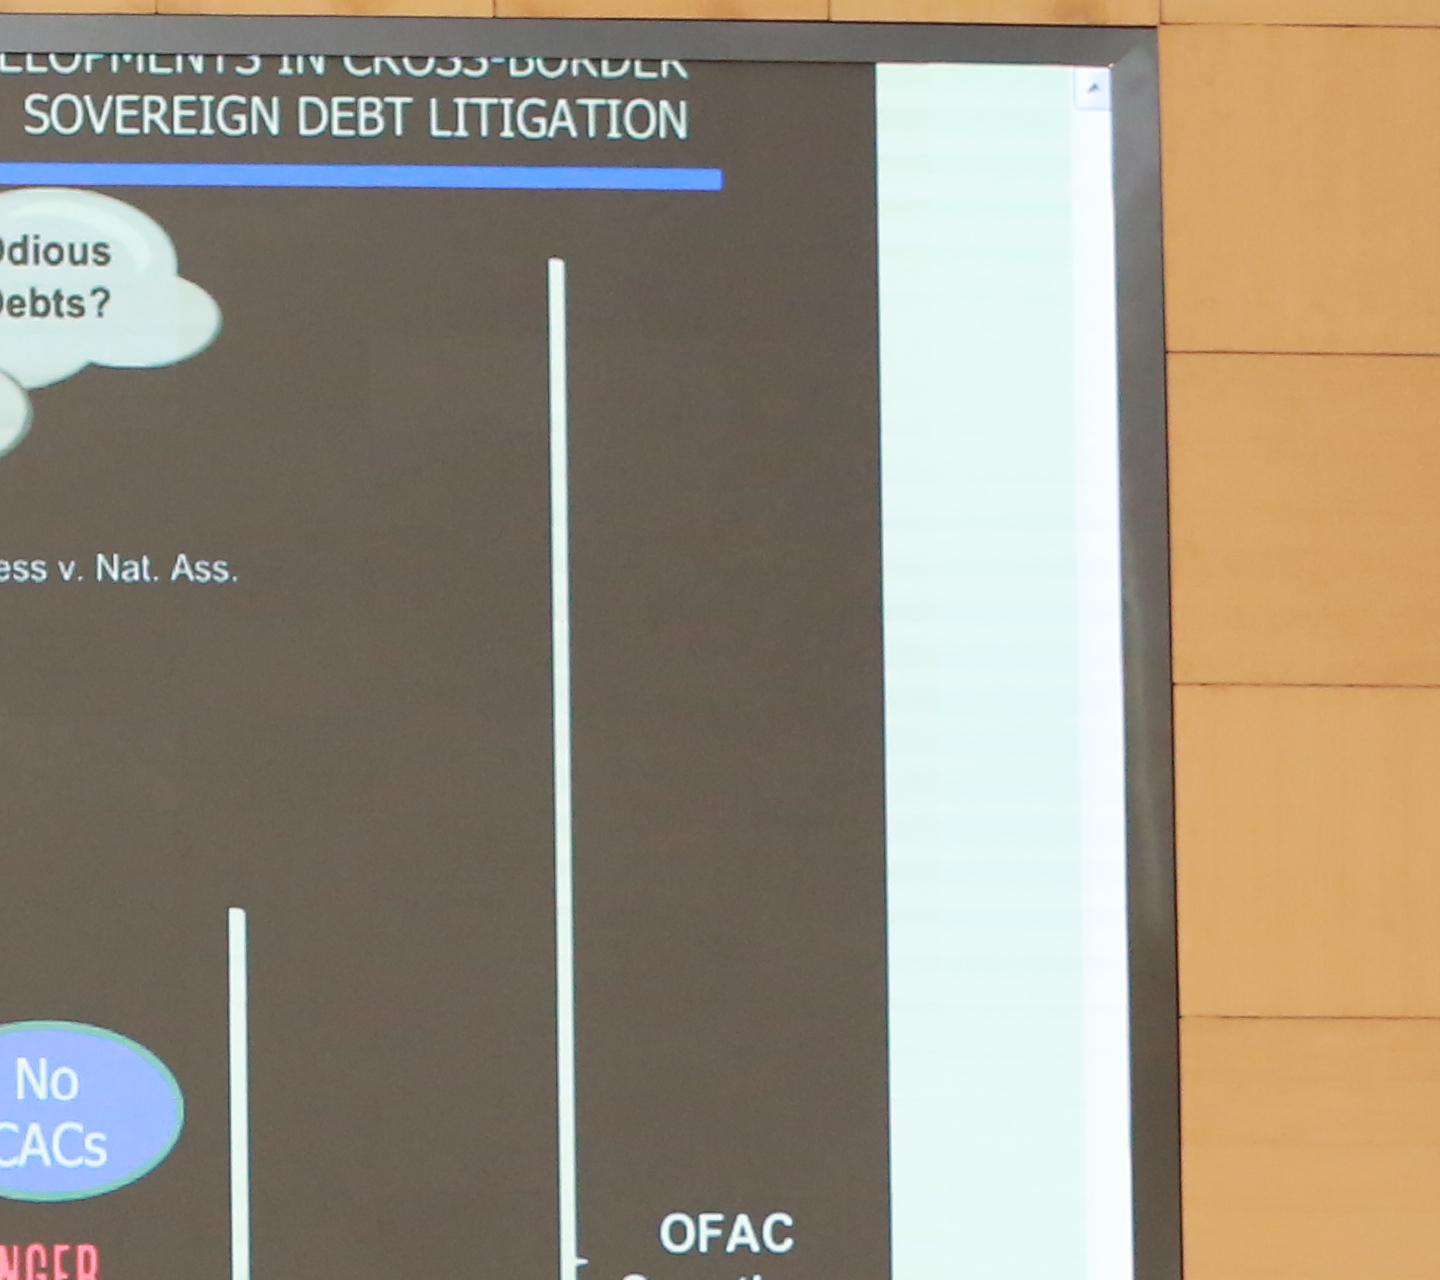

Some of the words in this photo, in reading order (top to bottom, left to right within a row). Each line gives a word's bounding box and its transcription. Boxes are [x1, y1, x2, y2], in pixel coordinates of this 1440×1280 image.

[25, 94, 280, 137] SOVEREIGN
[299, 96, 415, 138] DEBT
[431, 98, 688, 140] LITIGATION
[59, 561, 83, 582] v.
[98, 554, 158, 583] Nat.
[171, 554, 239, 584] Ass.
[17, 1058, 80, 1102] No
[661, 1213, 795, 1254] OFAC
